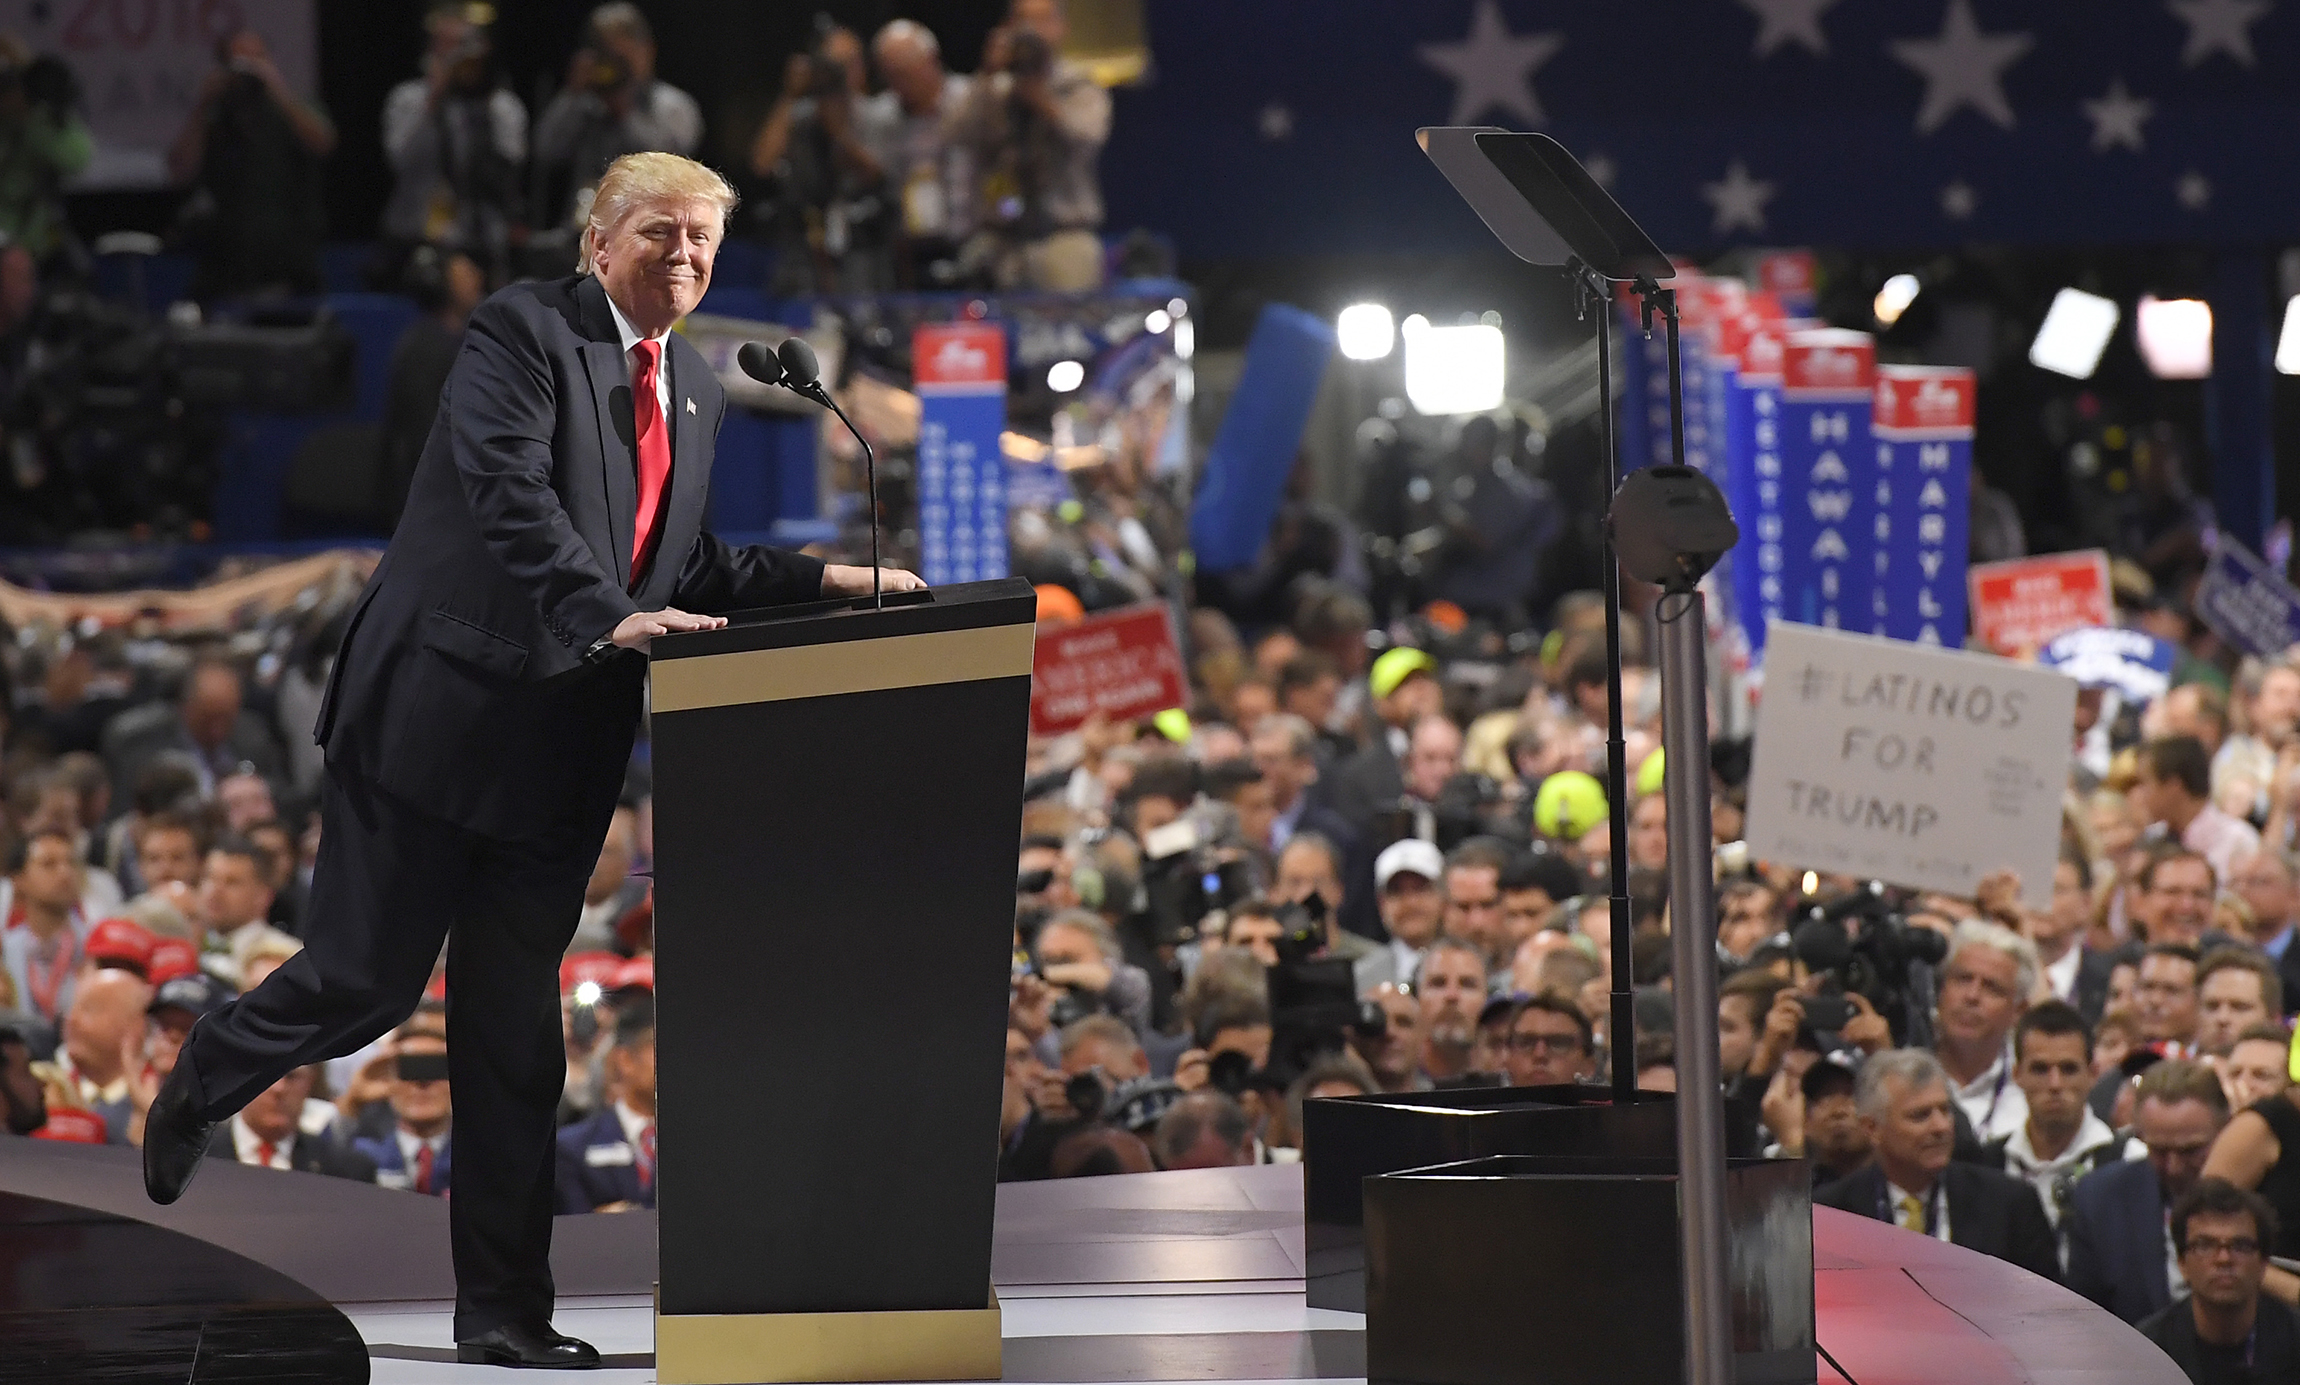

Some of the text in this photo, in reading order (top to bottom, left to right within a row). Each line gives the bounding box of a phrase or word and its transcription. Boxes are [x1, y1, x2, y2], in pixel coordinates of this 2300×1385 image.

[1791, 662, 2029, 729] #LATINOS
[1840, 726, 1936, 775] FOR
[1786, 778, 1939, 838] TRUMP
